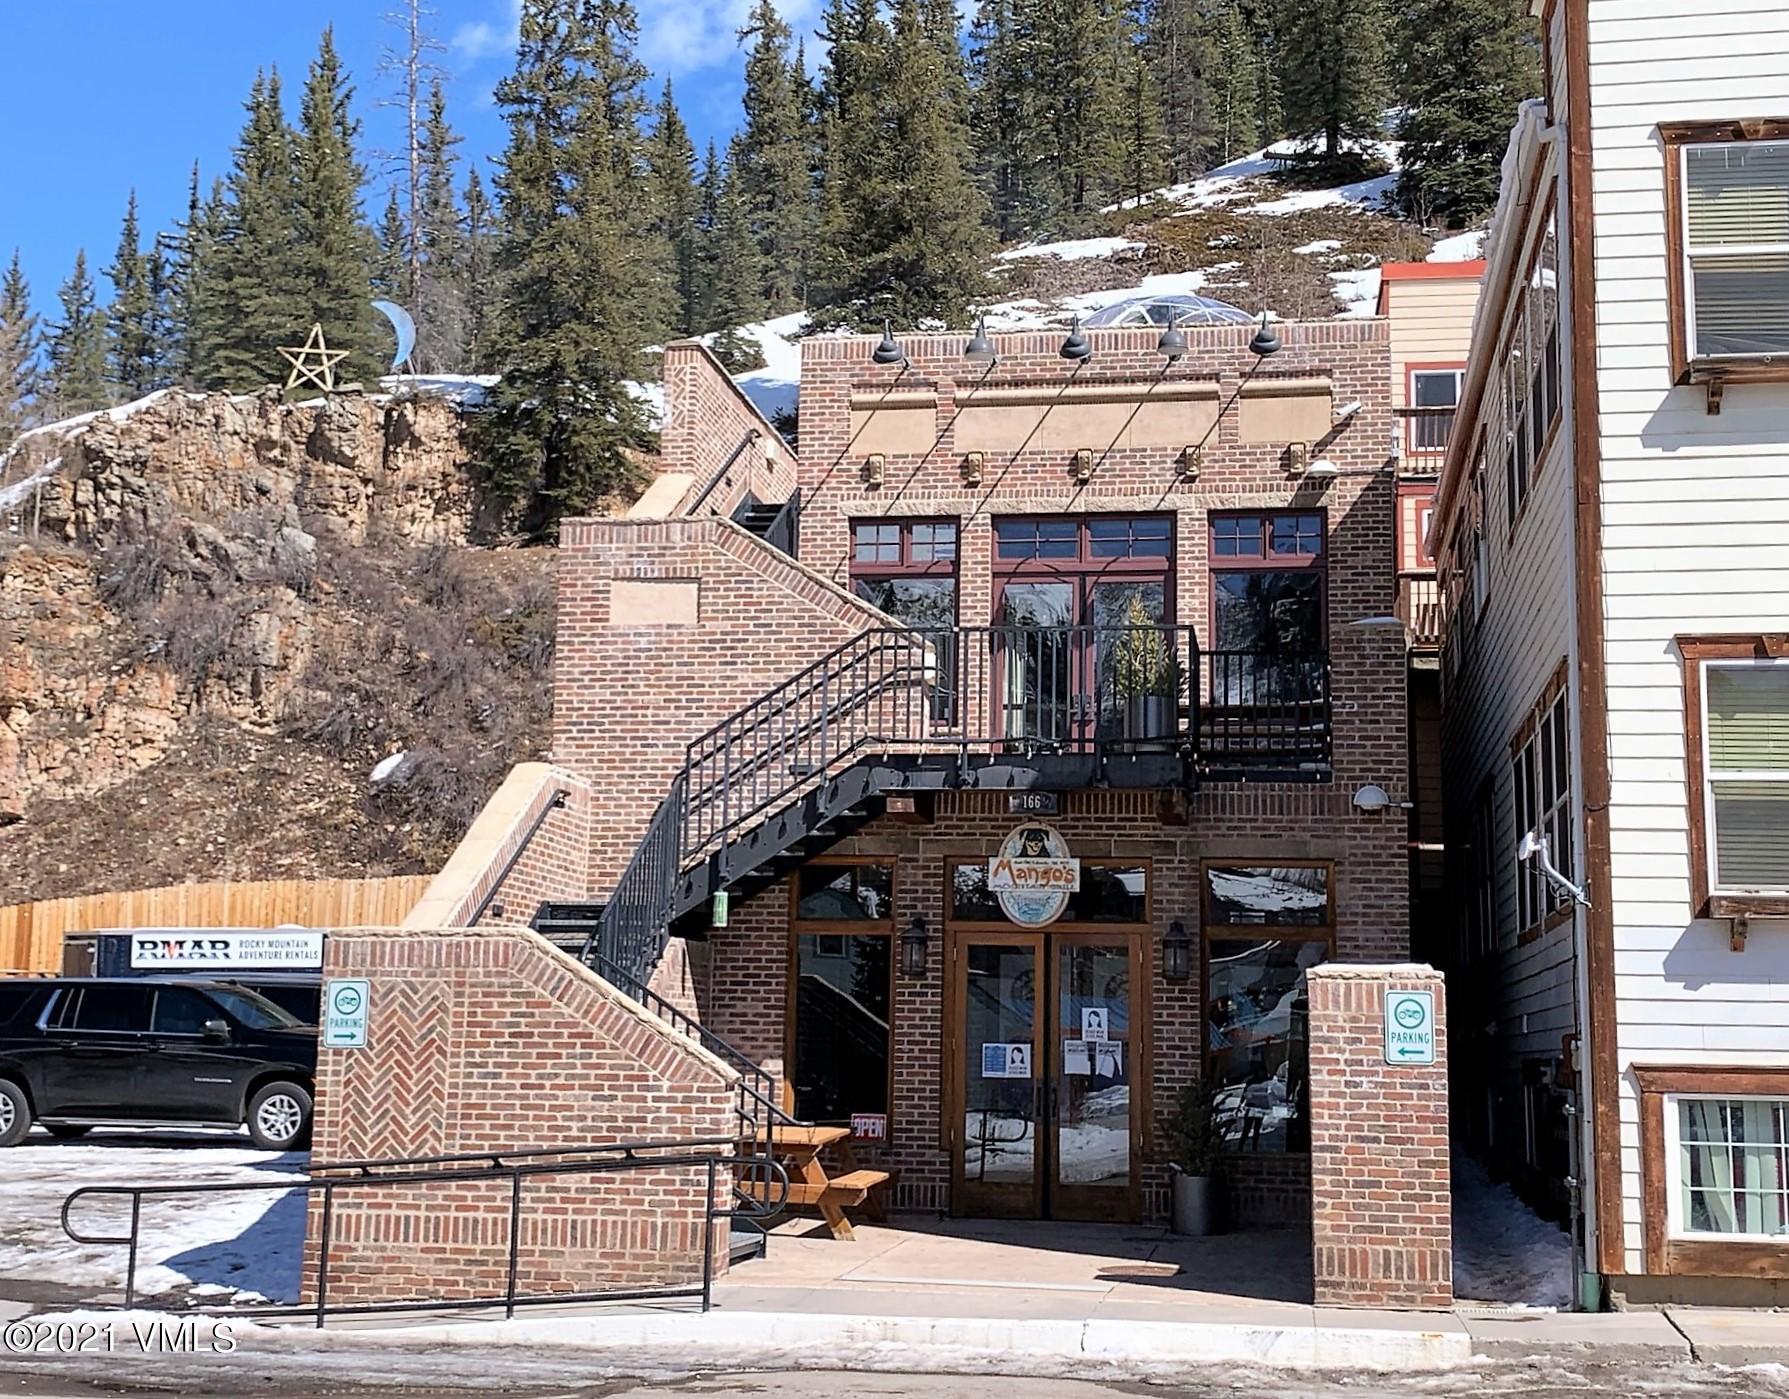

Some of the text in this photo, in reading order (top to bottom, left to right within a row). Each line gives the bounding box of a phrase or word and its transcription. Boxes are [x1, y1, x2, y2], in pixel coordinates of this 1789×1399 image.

[1023, 795, 1041, 809] 166
[992, 859, 1076, 887] Mango's
[239, 939, 309, 949] ROCKY MOUNTAIN
[239, 950, 319, 960] ADVENTURE RENTALS
[329, 1018, 363, 1029] PARKING
[1391, 1032, 1430, 1044] PARKING
[853, 1118, 884, 1137] OPEN
